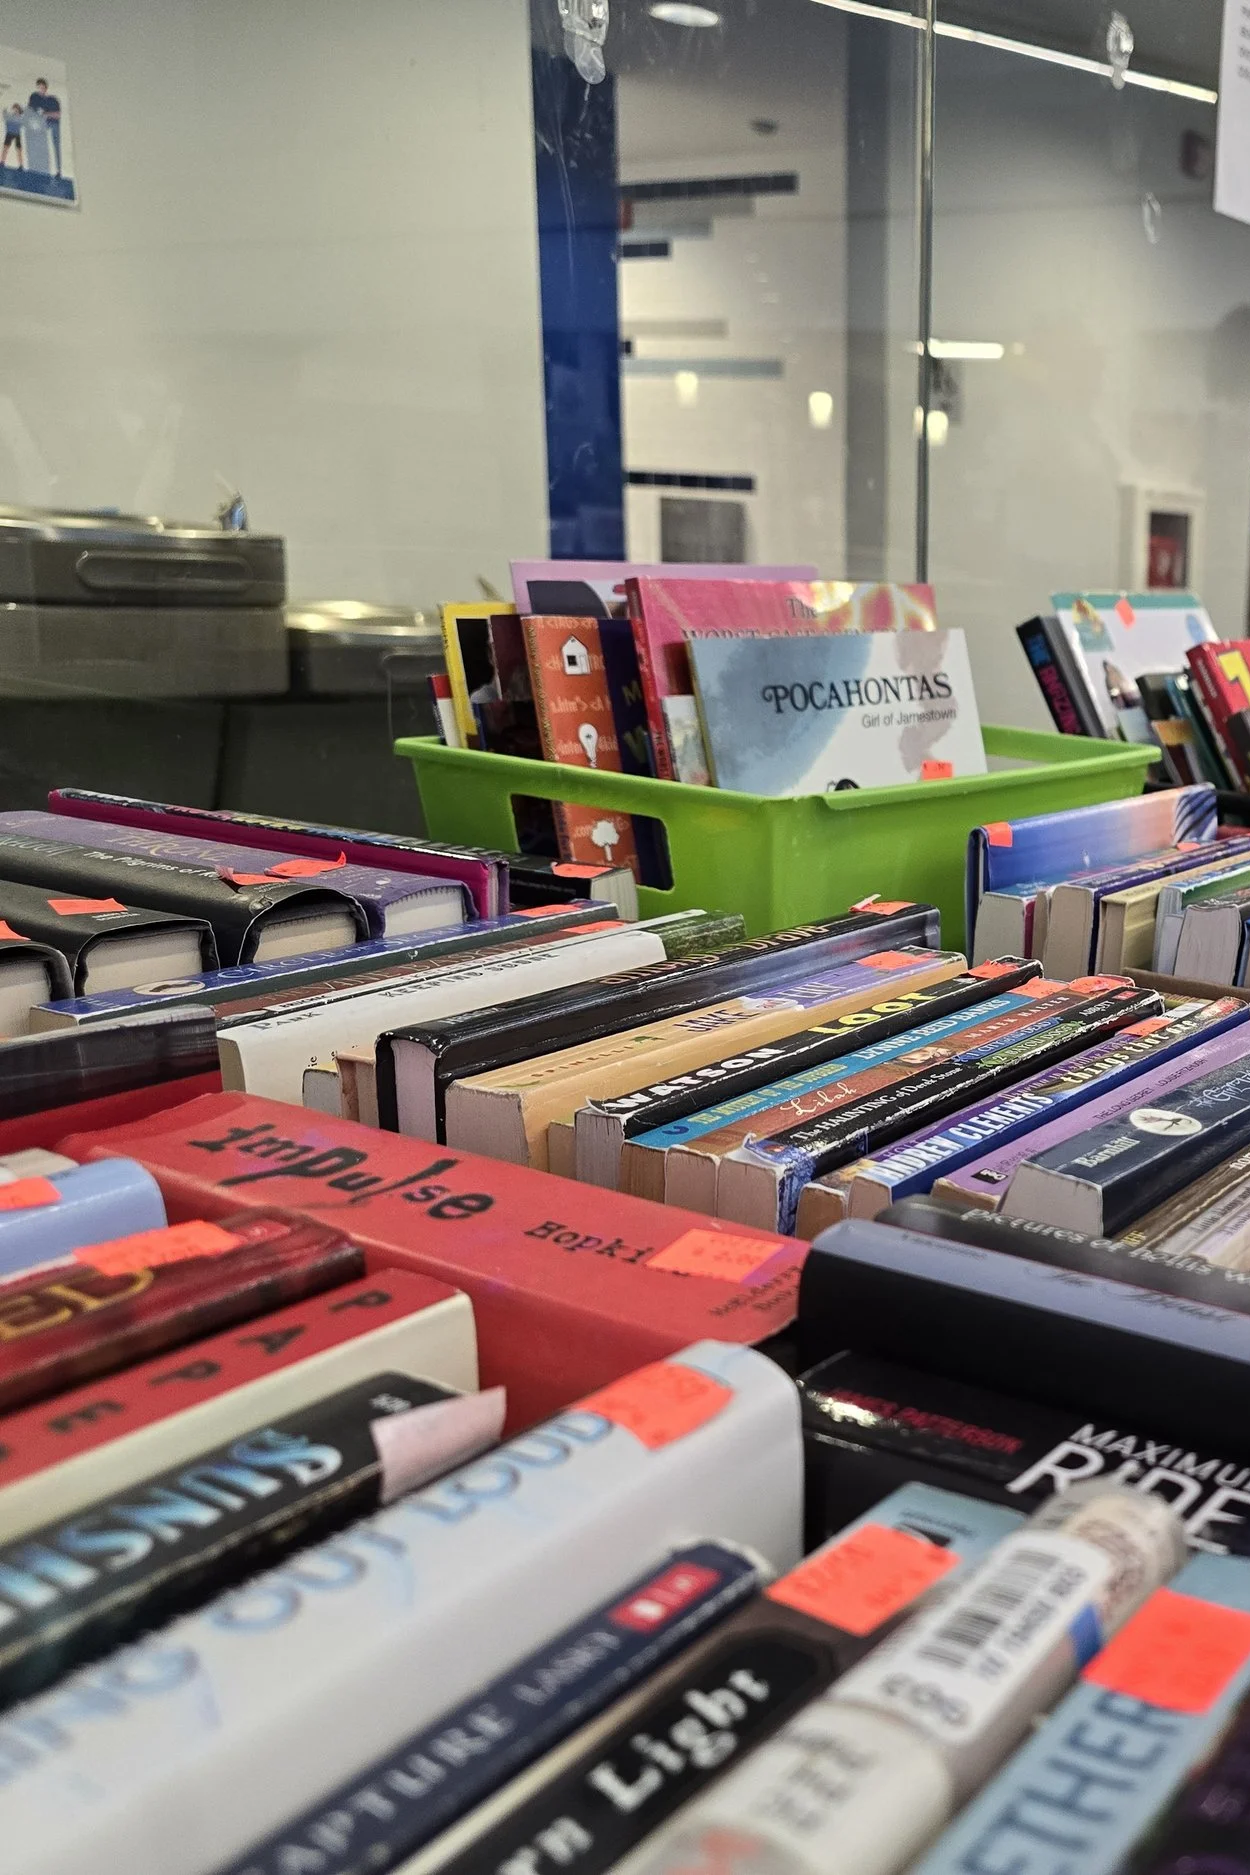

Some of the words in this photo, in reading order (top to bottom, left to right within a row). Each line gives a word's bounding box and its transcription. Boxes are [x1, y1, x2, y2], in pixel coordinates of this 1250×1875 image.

[762, 672, 953, 714] POCAHONTAS
[862, 713, 881, 729] Girl
[882, 712, 895, 727] of
[896, 707, 957, 726] Jamestown
[808, 992, 938, 1036] LOOT
[851, 1032, 915, 1061] LYNNE
[913, 1014, 955, 1044] REID
[955, 998, 1011, 1025] BANKS
[964, 1016, 1014, 1040] MAREK
[1020, 994, 1071, 1019] HALTER
[531, 1042, 634, 1081] SPINELLI
[604, 1045, 787, 1114] WATSON
[1061, 1050, 1130, 1085] things
[1124, 1030, 1170, 1055] that
[1168, 1018, 1198, 1035] are
[779, 1081, 859, 1117] Lilah
[789, 1122, 821, 1143] The
[820, 1092, 899, 1131] HAUNTING
[904, 1074, 936, 1098] Derek
[933, 1064, 965, 1084] Stone
[870, 1130, 956, 1182] ANDREW
[956, 1091, 1055, 1140] CLEMENTS
[1073, 1135, 1142, 1169] Barnhill
[188, 1122, 498, 1223] Impulse
[523, 1220, 690, 1277] Hopki
[408, 1407, 615, 1526] LOUD
[0, 1428, 345, 1626] SUNSH
[587, 1667, 771, 1814] Light
